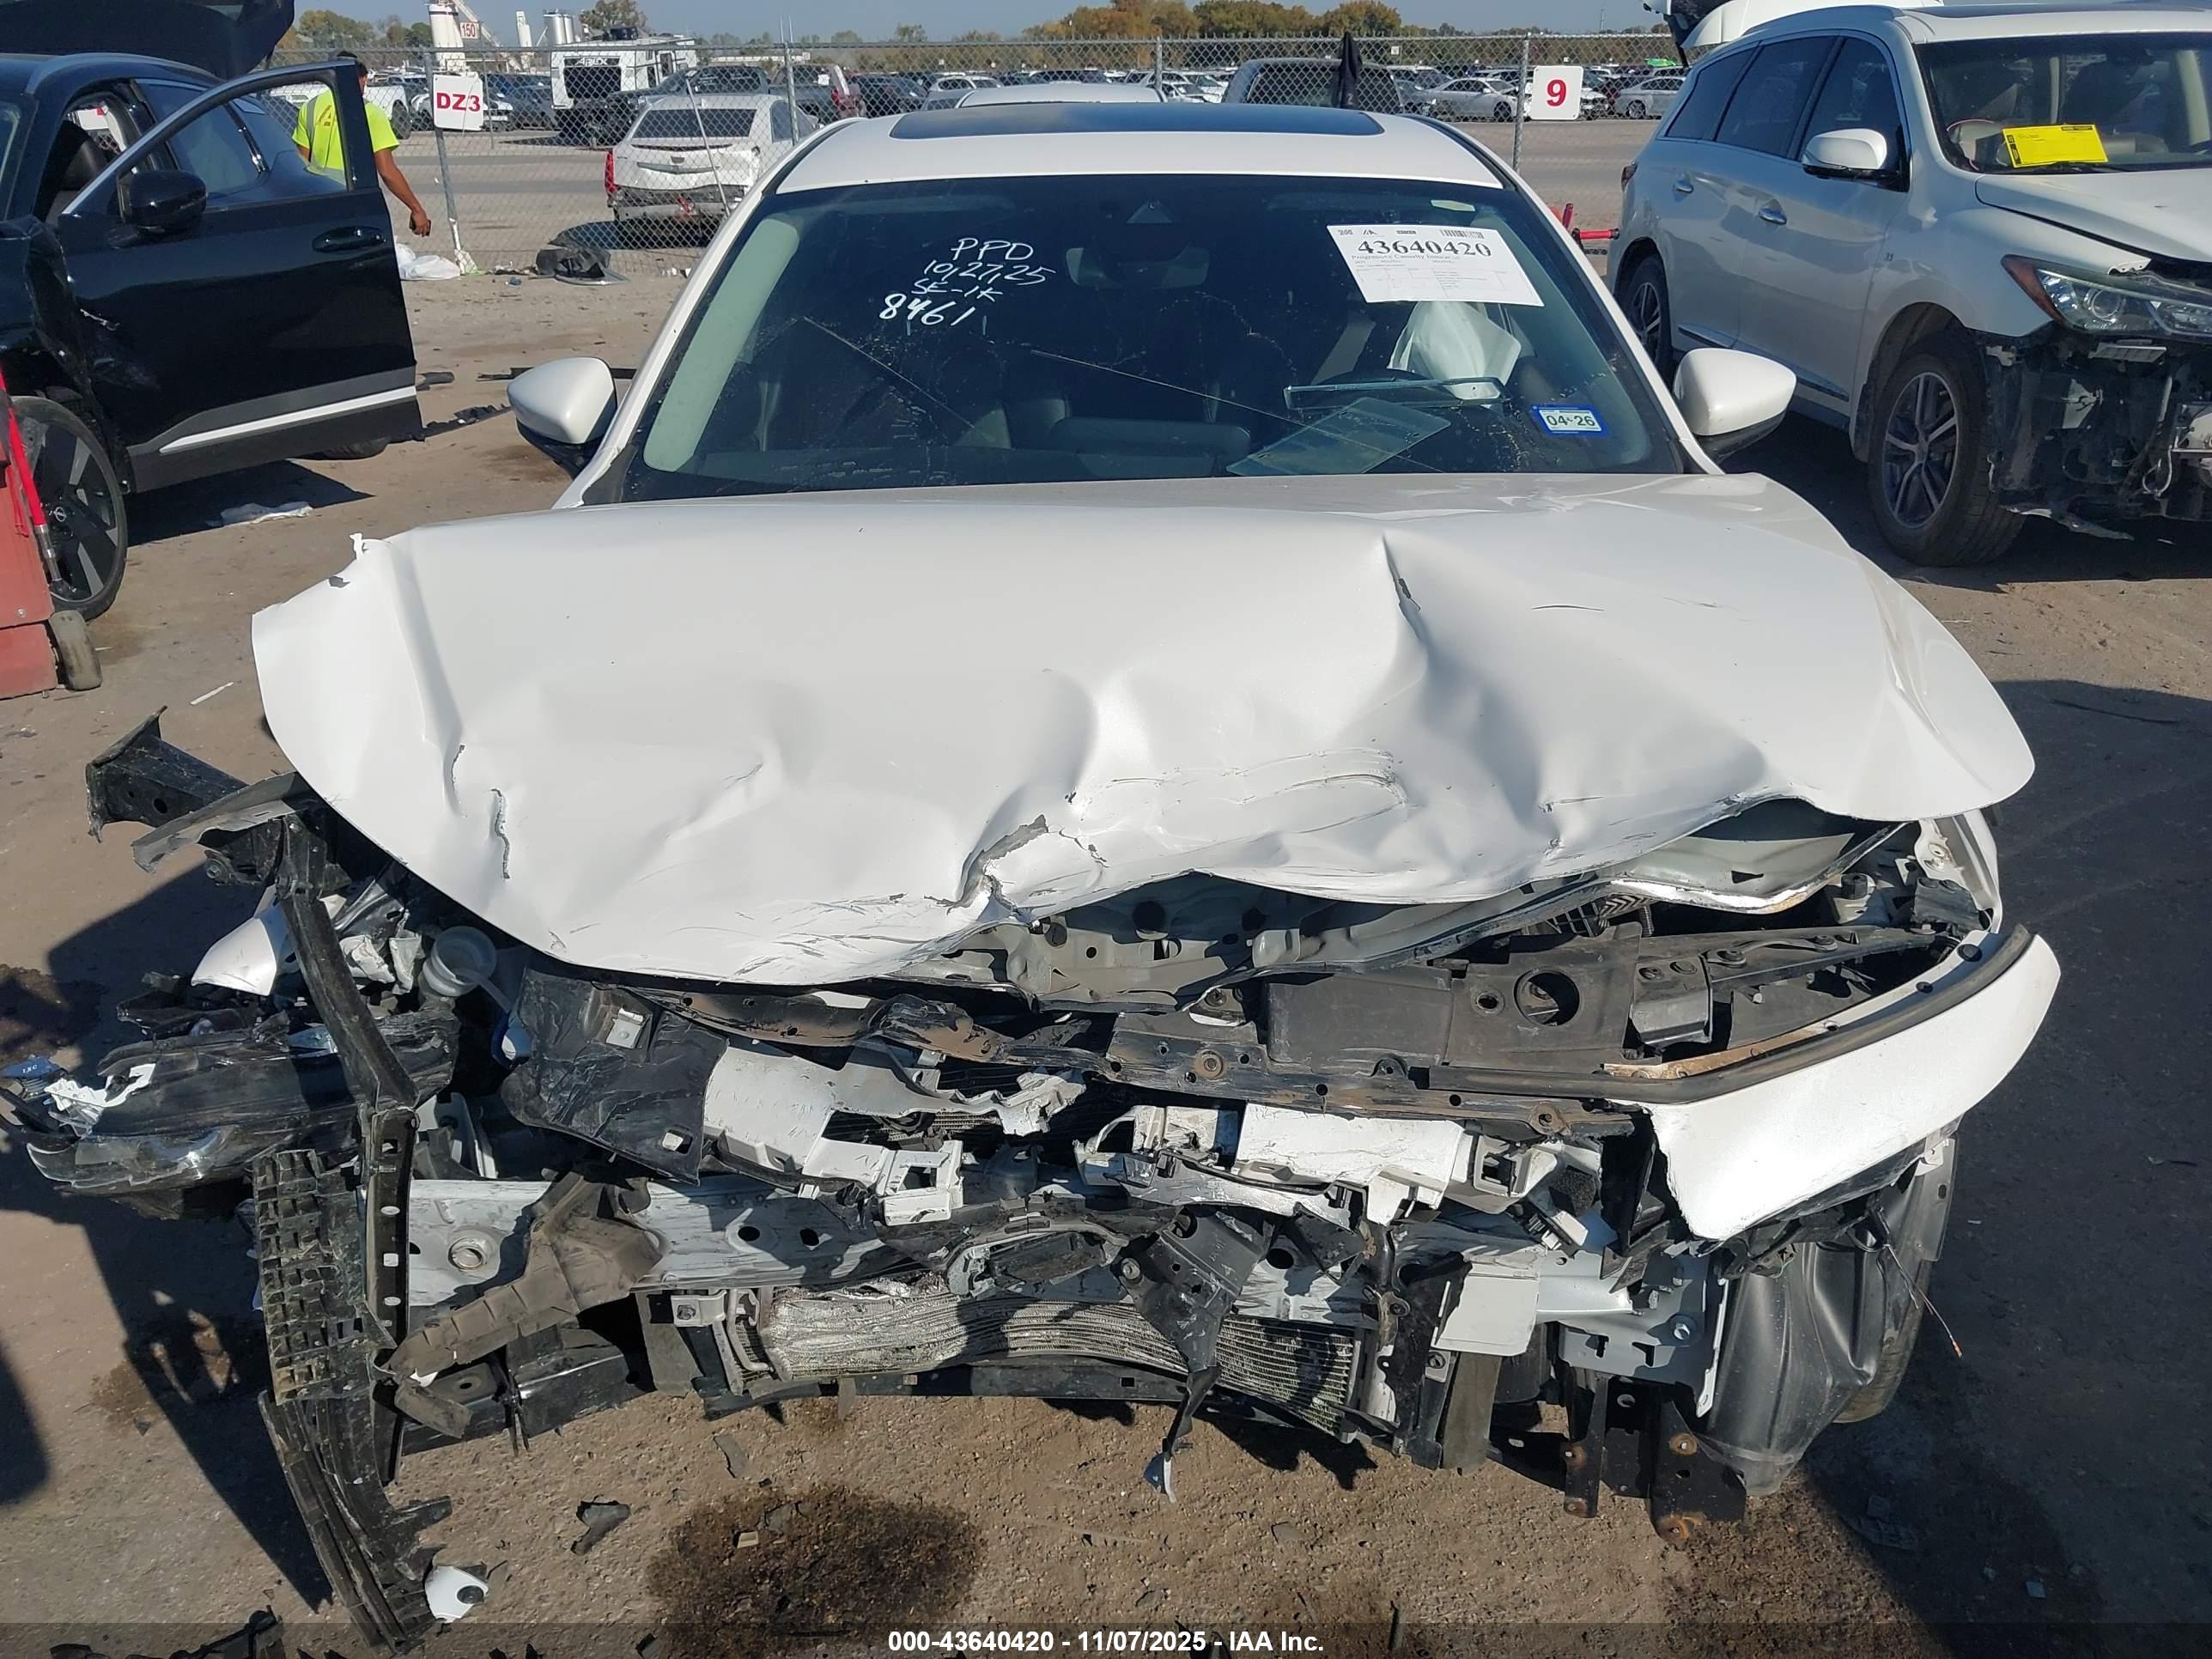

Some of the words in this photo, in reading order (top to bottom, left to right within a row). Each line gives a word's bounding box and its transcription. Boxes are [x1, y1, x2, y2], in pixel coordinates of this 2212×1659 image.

[461, 23, 477, 38] 150
[436, 92, 481, 112] DZ3
[1547, 79, 1567, 107] 9
[951, 238, 1034, 260] PPD
[1358, 240, 1492, 257] 43640420
[879, 294, 975, 326] 8461
